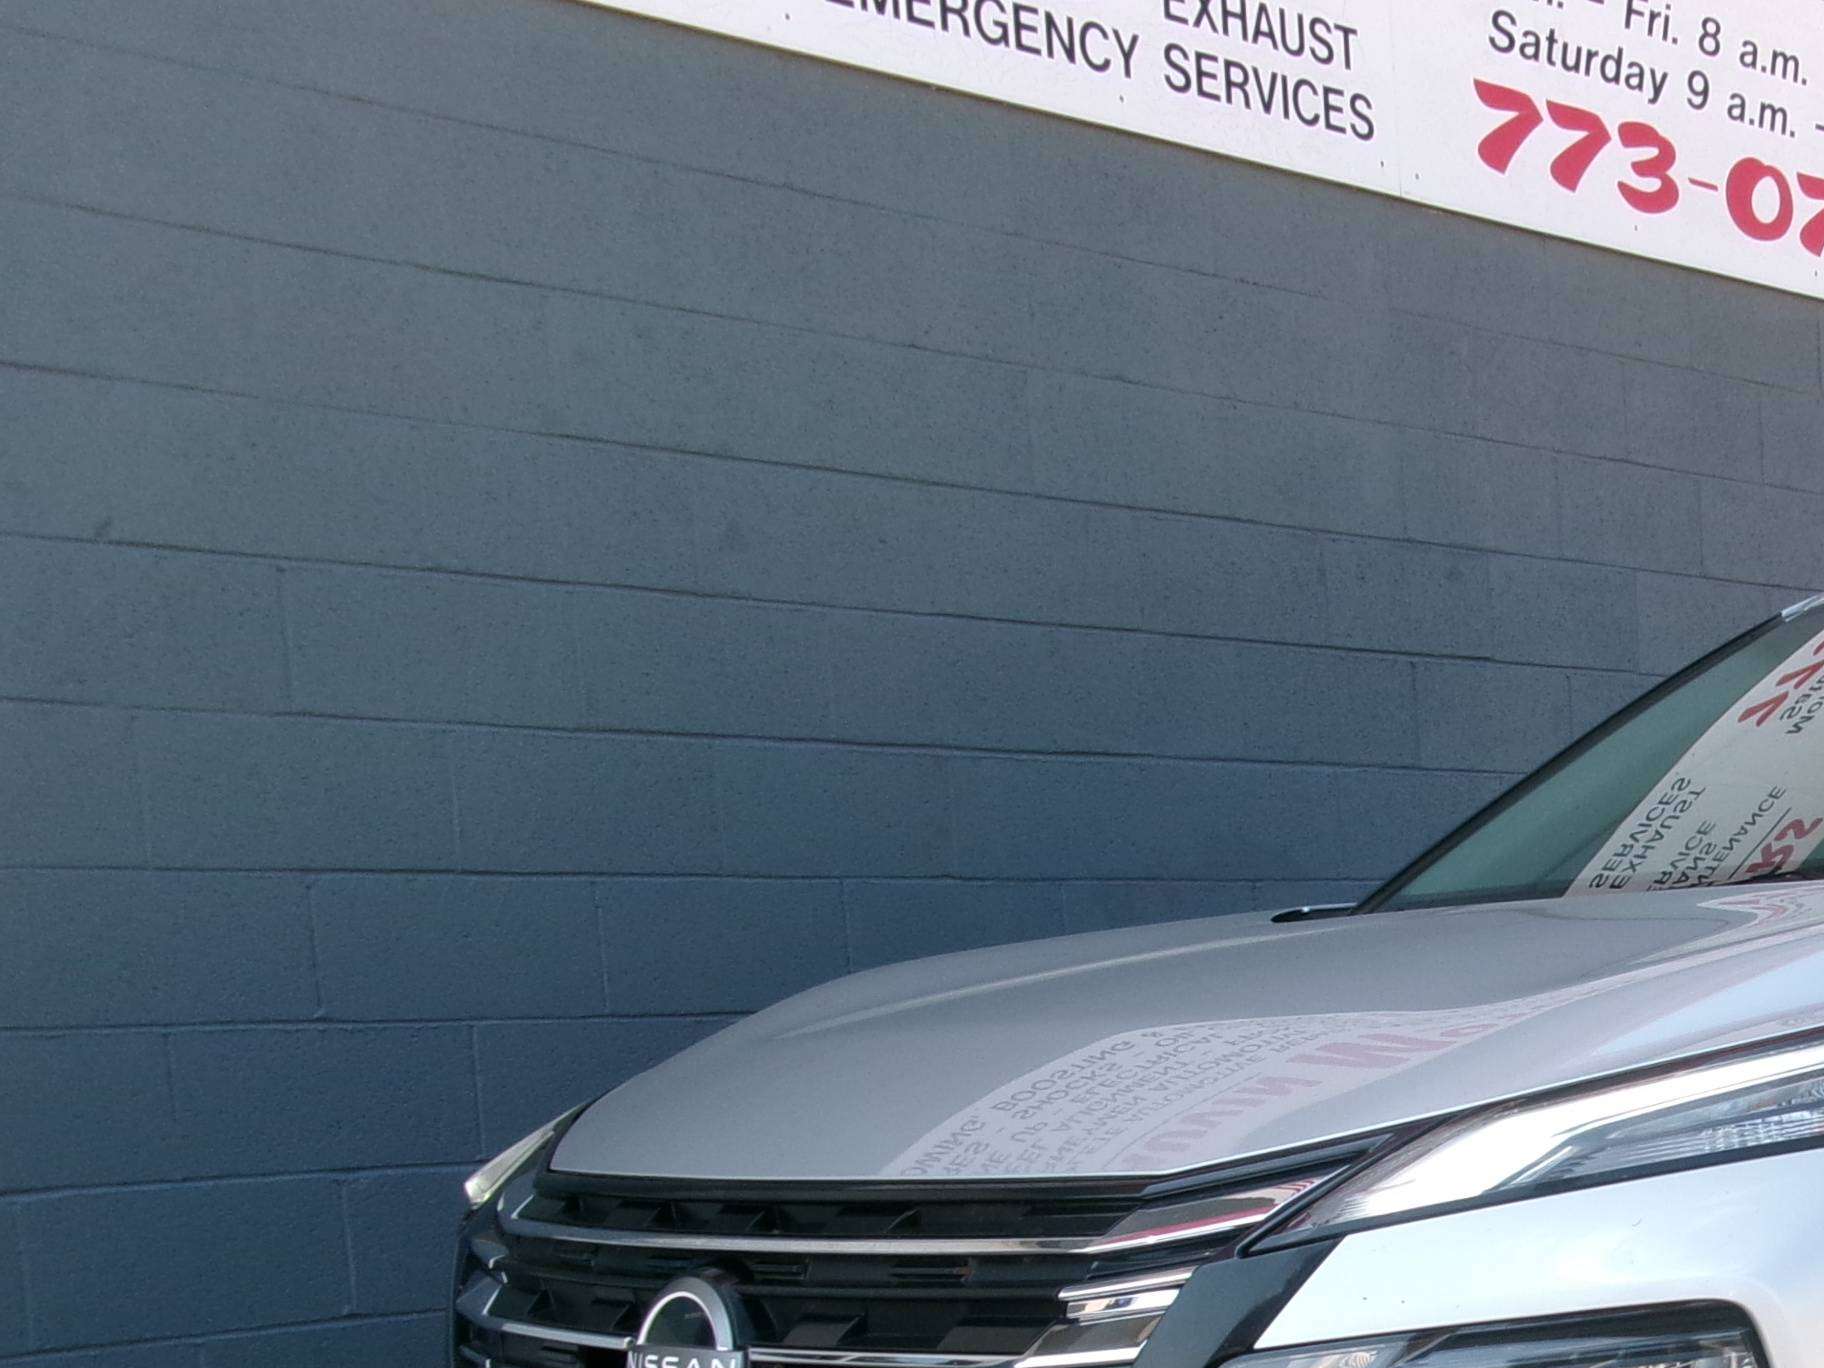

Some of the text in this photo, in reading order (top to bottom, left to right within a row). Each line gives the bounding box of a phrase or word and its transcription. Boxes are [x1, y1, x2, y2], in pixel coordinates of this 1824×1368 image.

[1163, 43, 1375, 142] SERVICES
[1488, 9, 1669, 105] Saturday
[1686, 70, 1710, 110] 9
[1727, 92, 1796, 138] a.m.
[1698, 16, 1721, 57] 8
[1739, 39, 1808, 86] a.m.
